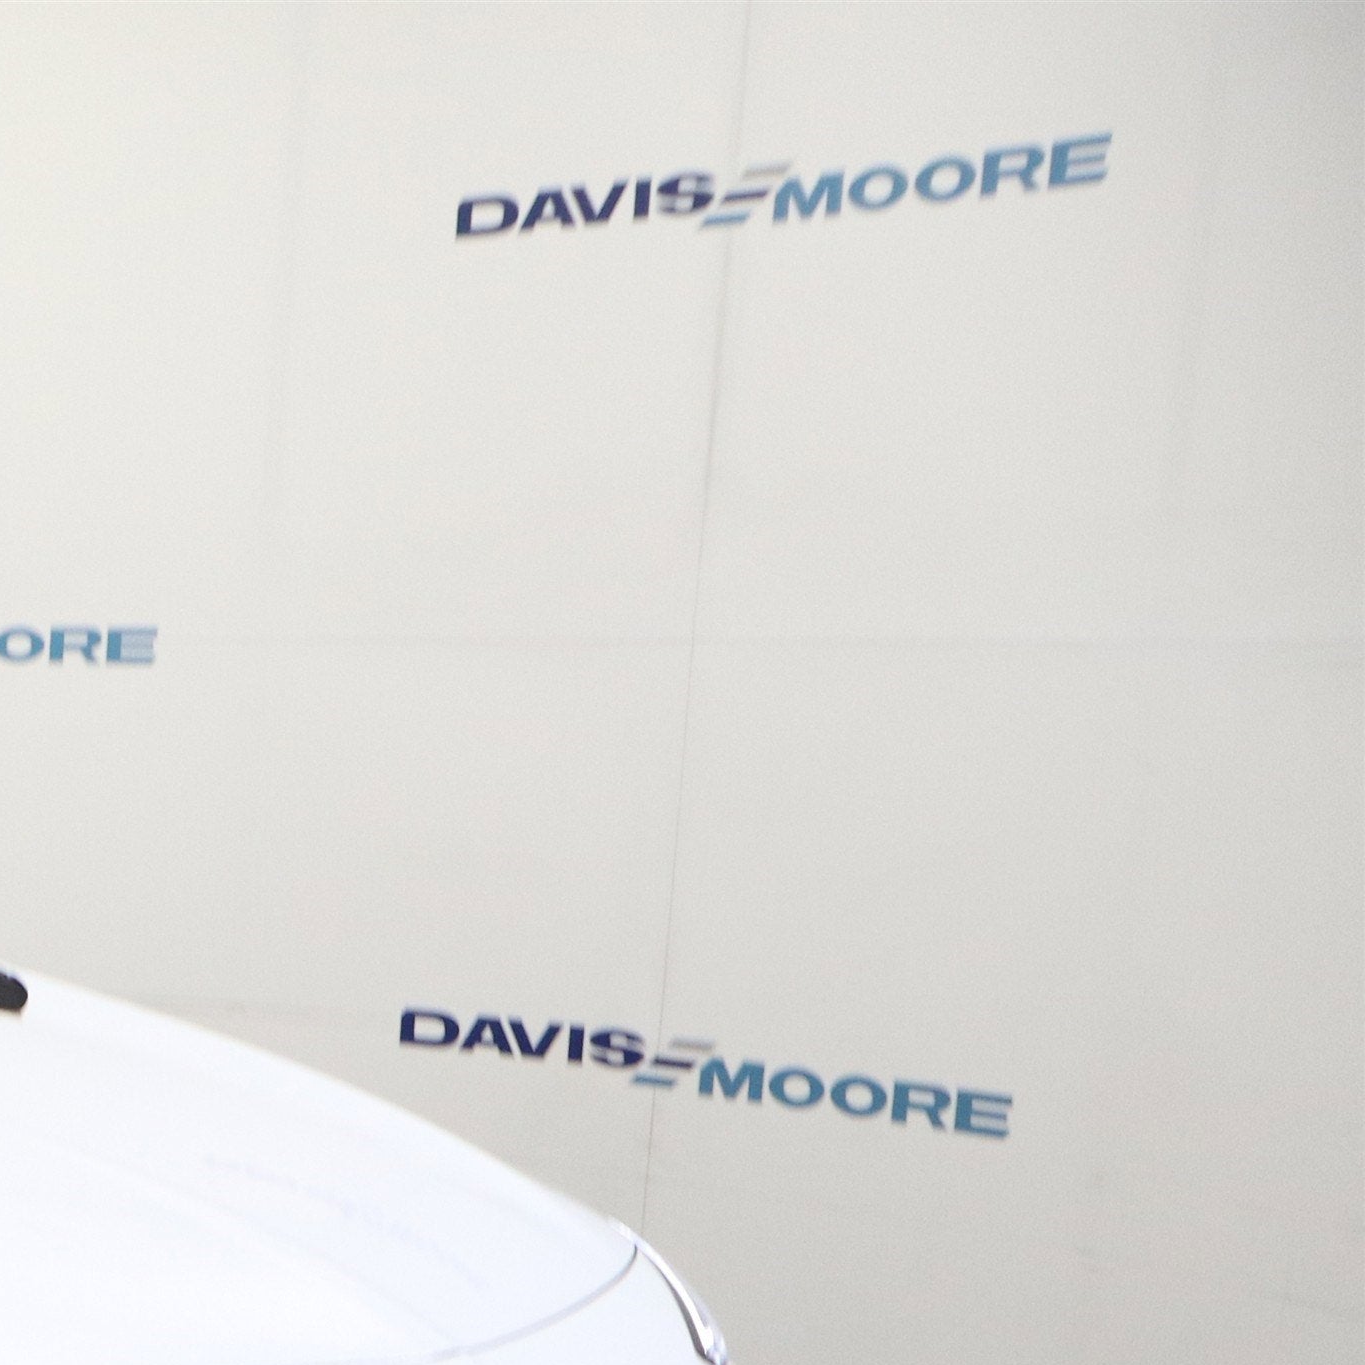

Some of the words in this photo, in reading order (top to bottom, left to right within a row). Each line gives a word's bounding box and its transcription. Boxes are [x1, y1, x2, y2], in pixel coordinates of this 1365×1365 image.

[455, 170, 712, 240] DAVIS
[772, 131, 1113, 225] MOORE
[399, 1006, 644, 1071] DAVIS
[698, 1057, 1013, 1138] MOORE
